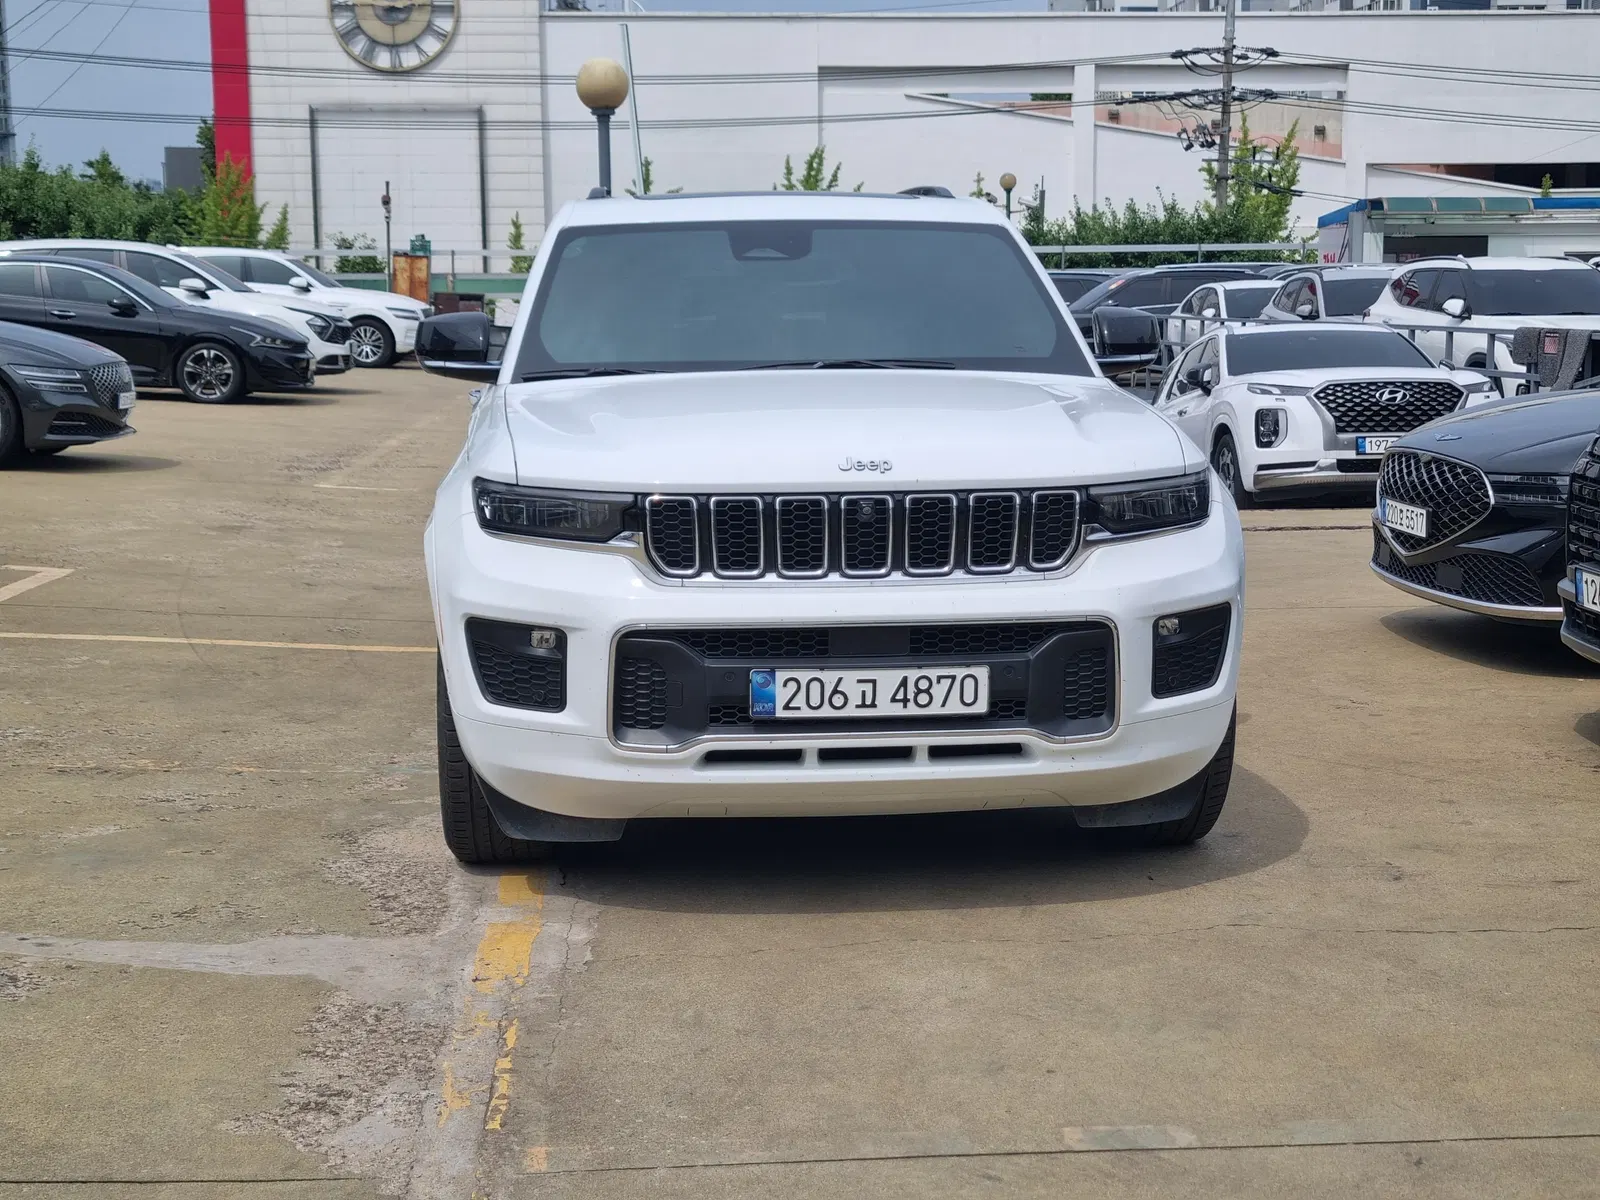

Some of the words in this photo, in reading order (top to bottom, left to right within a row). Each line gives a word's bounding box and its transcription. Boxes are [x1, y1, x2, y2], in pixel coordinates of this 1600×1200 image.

[1368, 439, 1393, 451] 197
[838, 456, 893, 474] Jeep
[1406, 508, 1425, 533] 5517
[1584, 577, 1600, 608] 12
[782, 676, 878, 711] 206고
[889, 673, 979, 709] 4870
[753, 702, 774, 712] KOR
